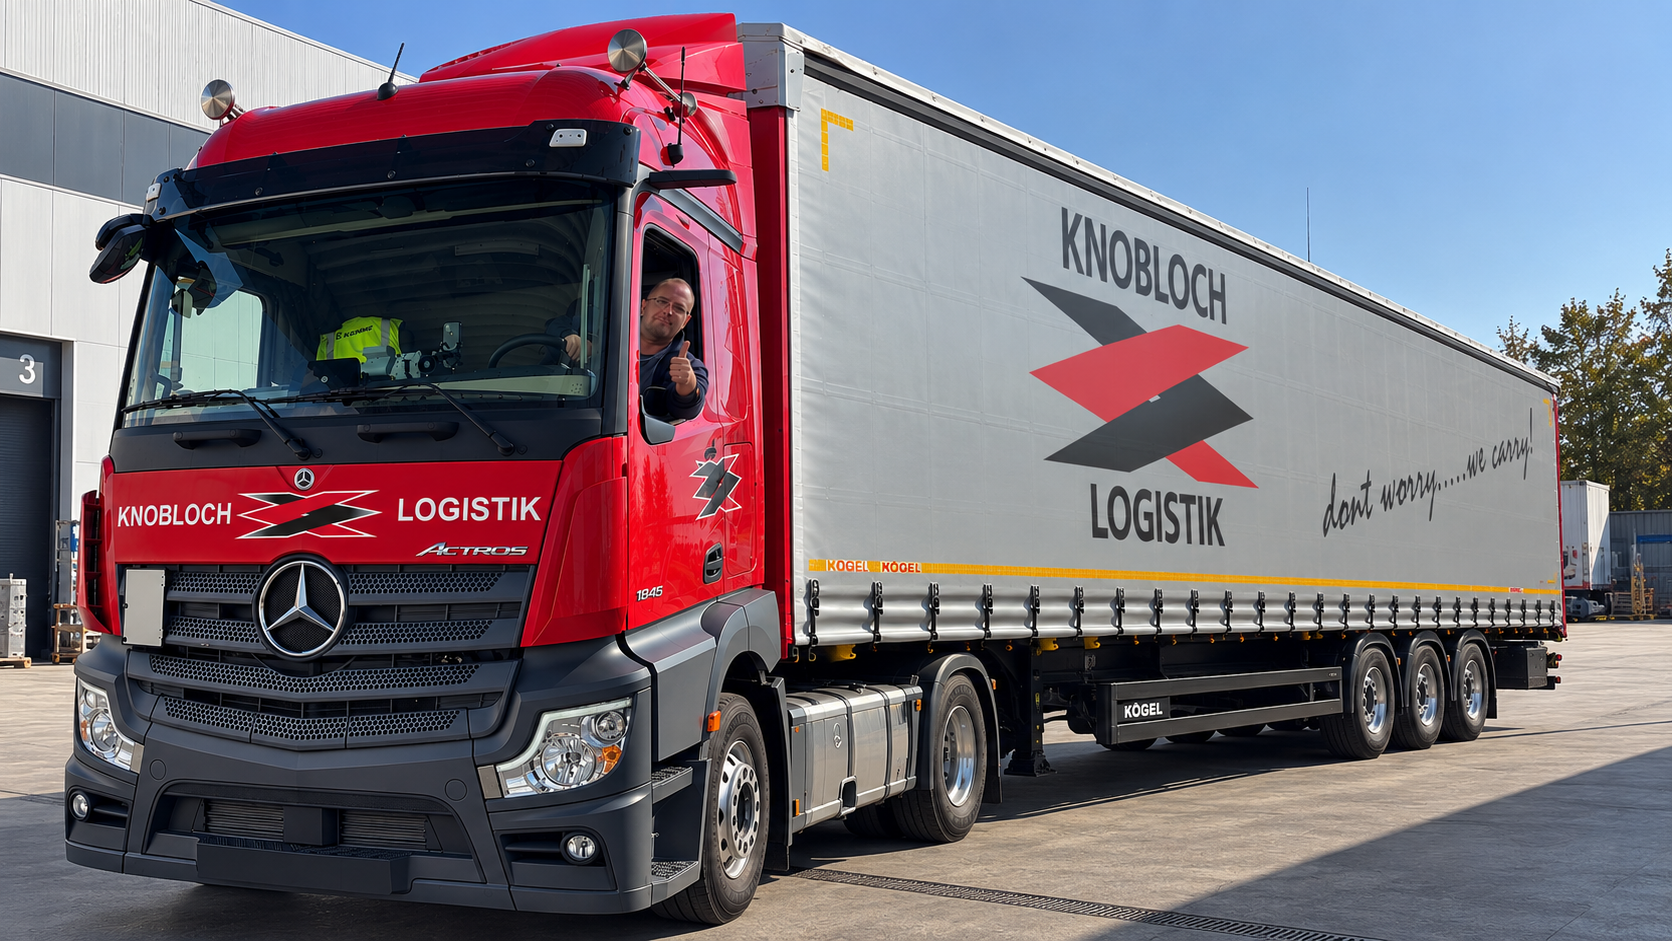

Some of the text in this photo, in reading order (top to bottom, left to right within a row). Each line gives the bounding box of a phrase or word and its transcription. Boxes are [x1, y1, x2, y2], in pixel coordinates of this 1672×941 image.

[1061, 206, 1227, 325] KNOBLOCH
[18, 353, 36, 385] 3
[1322, 469, 1373, 538] dont
[1492, 407, 1533, 480] carry!
[117, 496, 542, 527] KNOBLOCH LOGISTIK
[1090, 483, 1226, 547] LOGISTIK
[415, 541, 529, 557] ACTROS
[636, 585, 663, 602] 1845
[1124, 702, 1163, 719] KÖGEL
